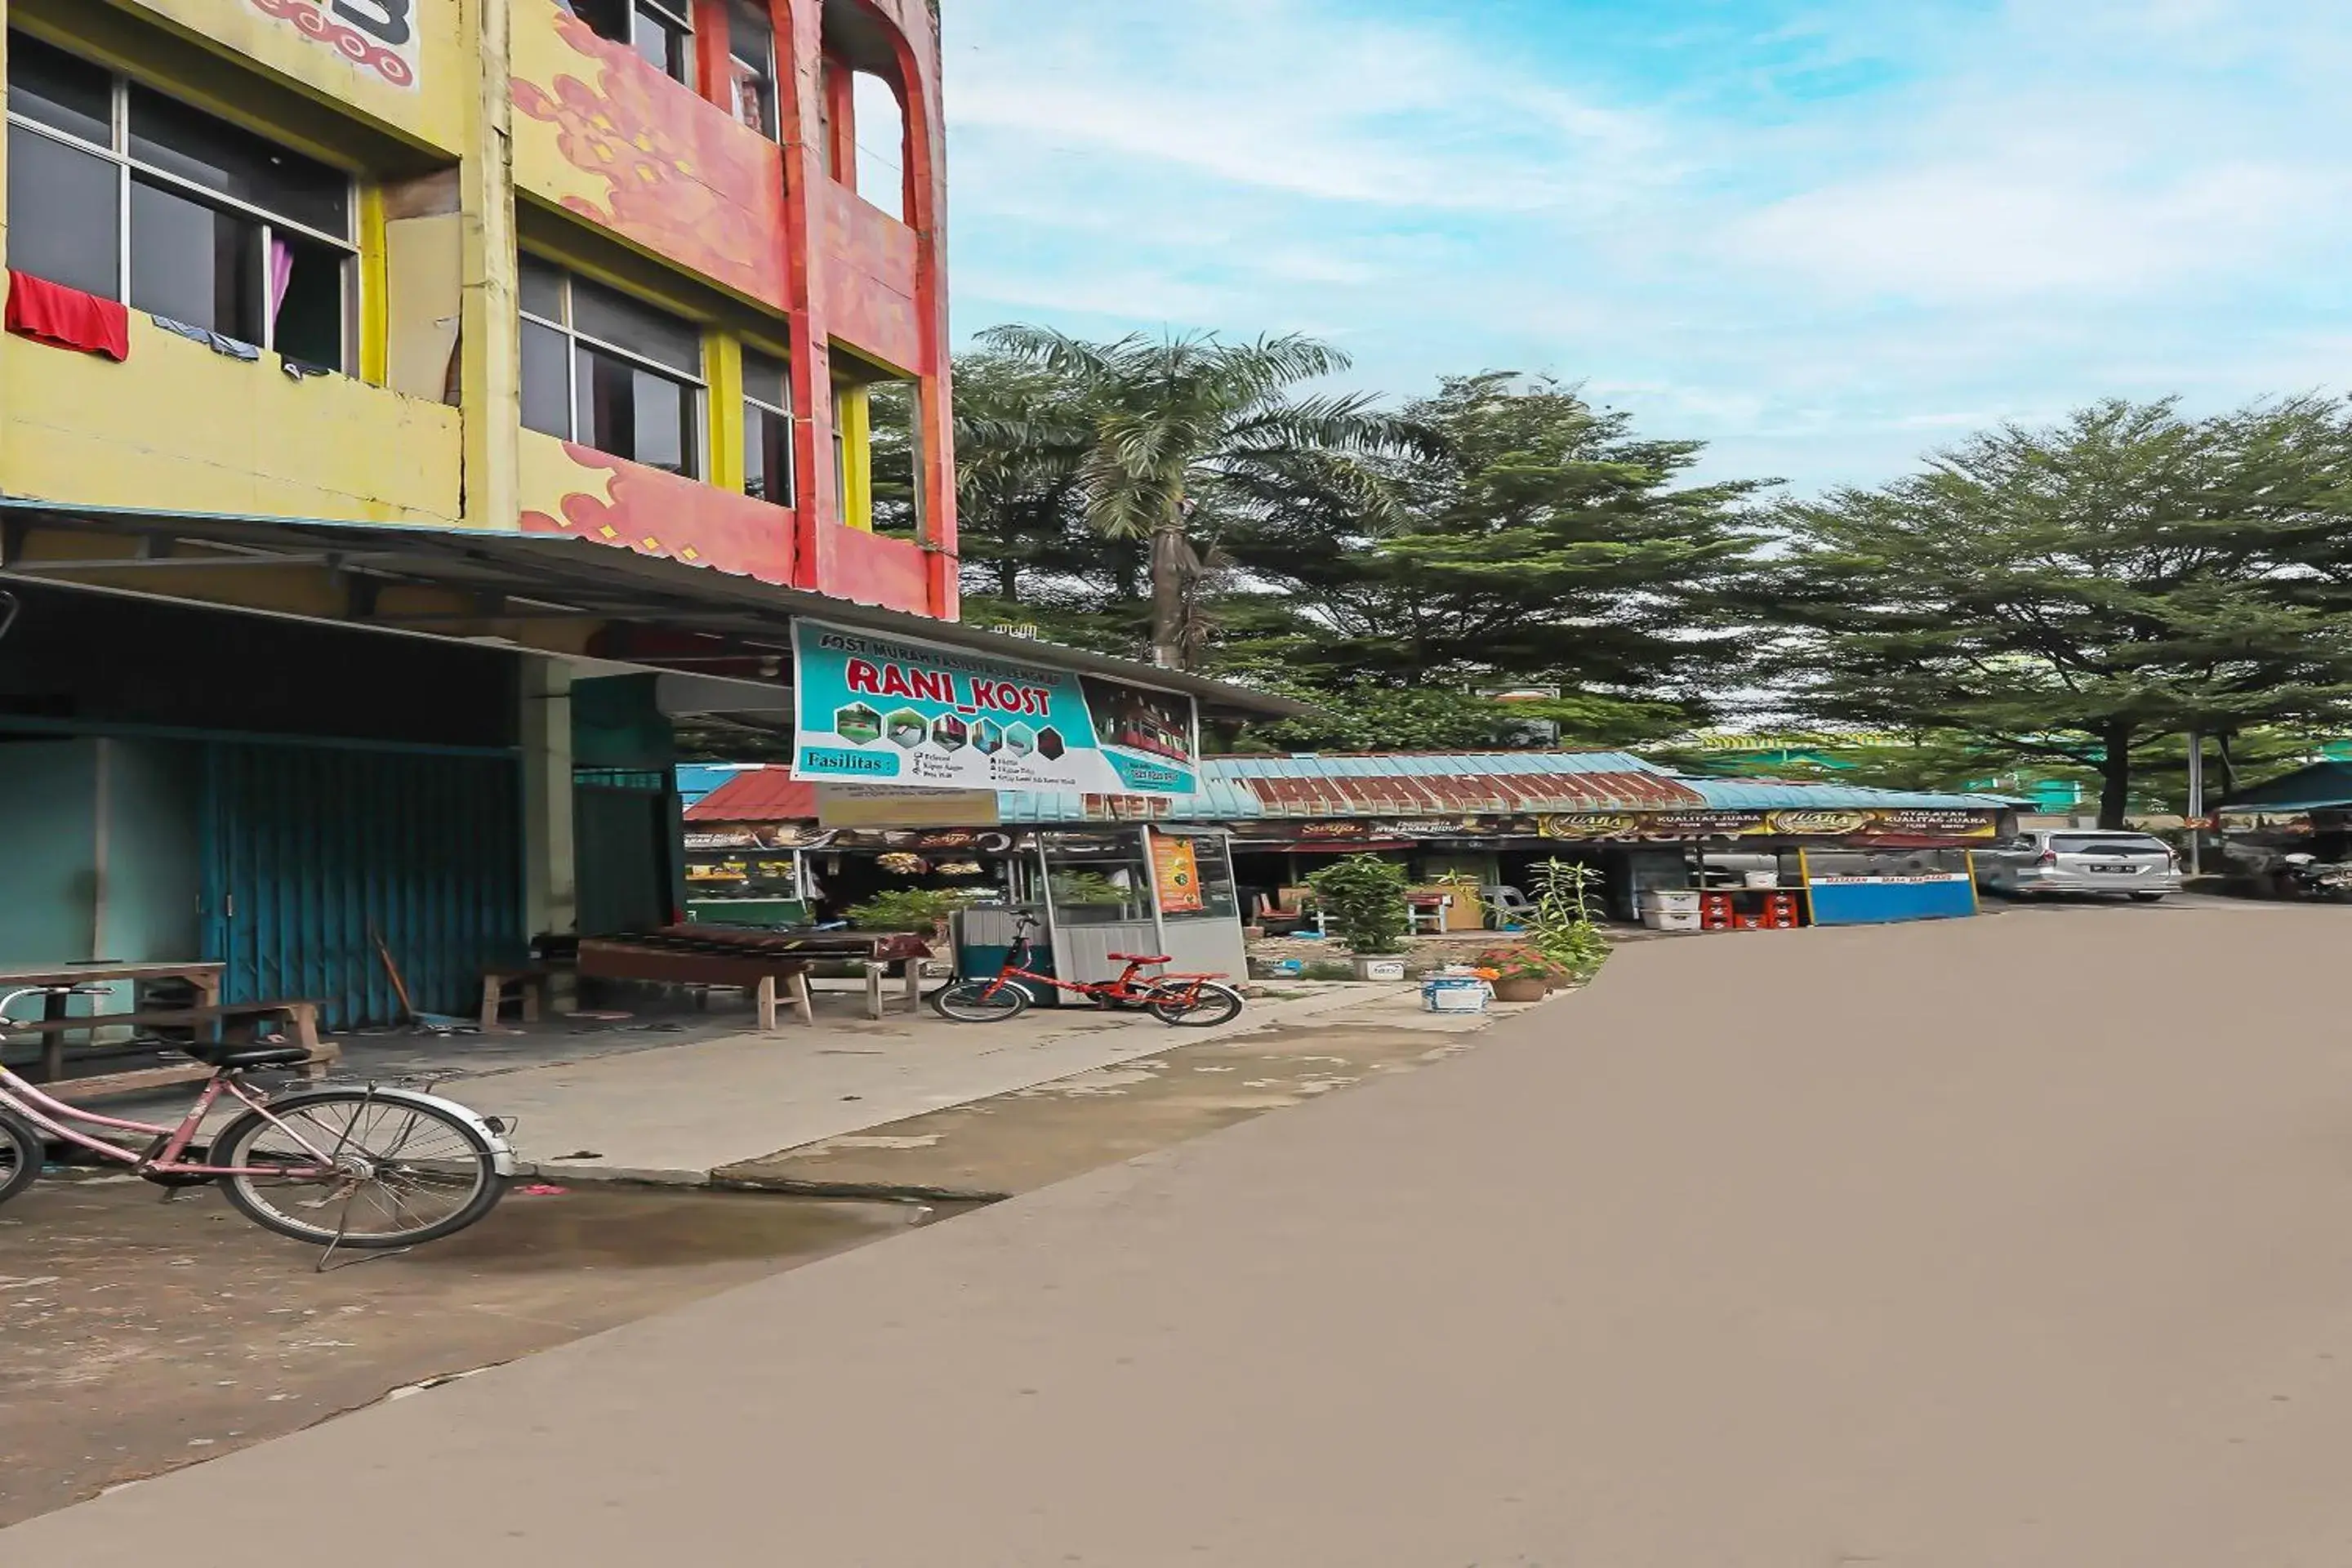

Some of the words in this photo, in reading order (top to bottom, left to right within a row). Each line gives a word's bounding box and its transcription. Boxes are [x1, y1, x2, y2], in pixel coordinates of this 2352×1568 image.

[808, 751, 882, 770] Fasilitas
[1656, 814, 1717, 822] KUALITAS
[1720, 814, 1762, 822] JUARA
[1884, 816, 1944, 824] KUALITAS
[1947, 817, 1988, 825] JUARA
